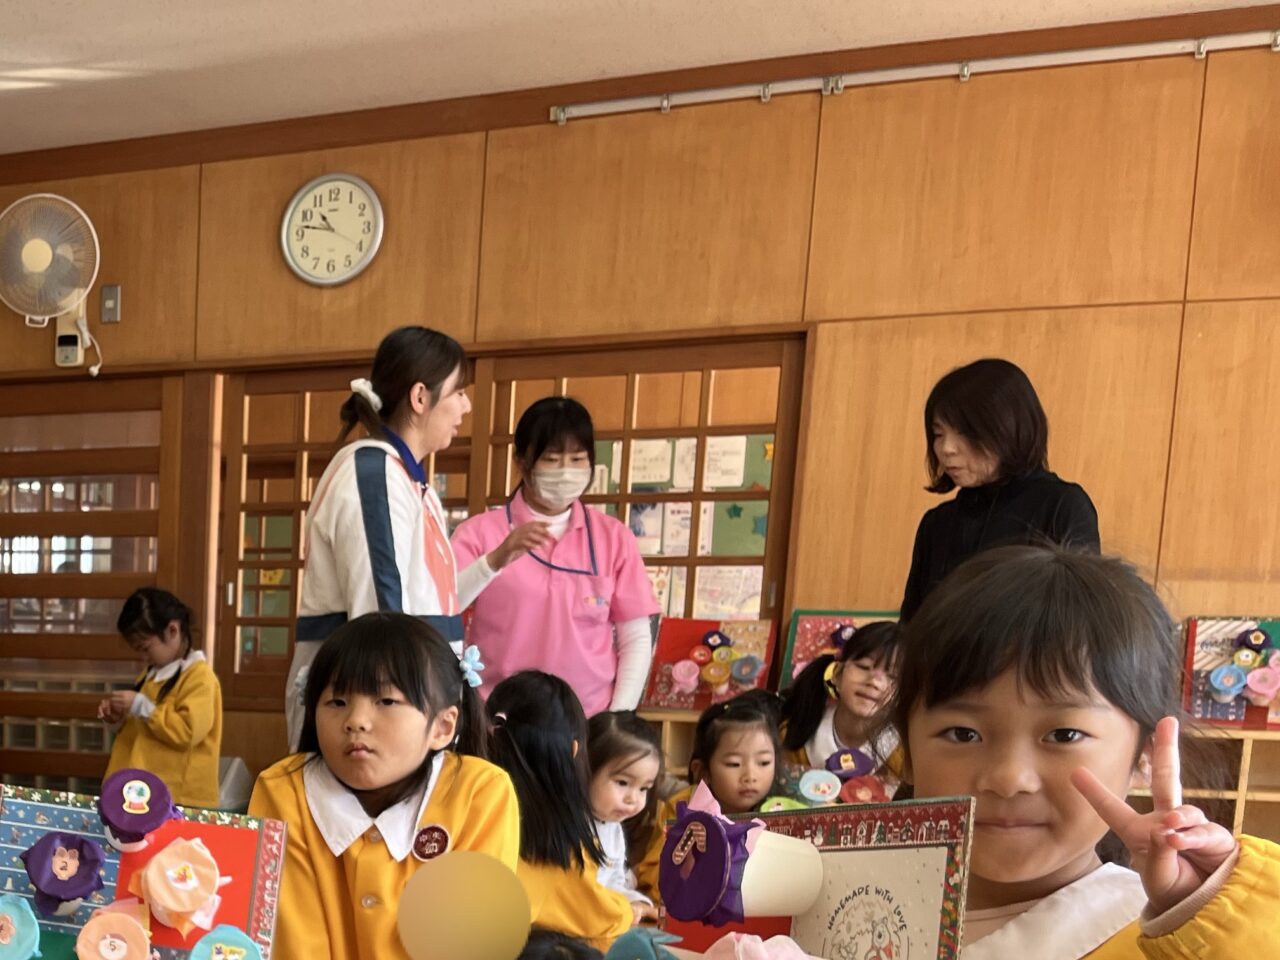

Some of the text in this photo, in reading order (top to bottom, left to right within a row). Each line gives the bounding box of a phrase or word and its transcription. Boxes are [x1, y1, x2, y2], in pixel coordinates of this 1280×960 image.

[313, 194, 322, 208] 11
[328, 187, 341, 202] 12
[348, 190, 353, 204] 1
[301, 208, 313, 222] 10
[358, 203, 366, 217] 2
[362, 221, 371, 234] 3
[296, 229, 305, 241] 9
[301, 245, 309, 258] 8
[356, 240, 363, 252] 4
[312, 257, 320, 270] 7
[326, 259, 335, 273] 6
[344, 255, 352, 268] 5
[827, 884, 908, 931] HOMEMADE WITH LOVE
[109, 941, 117, 952] 5
